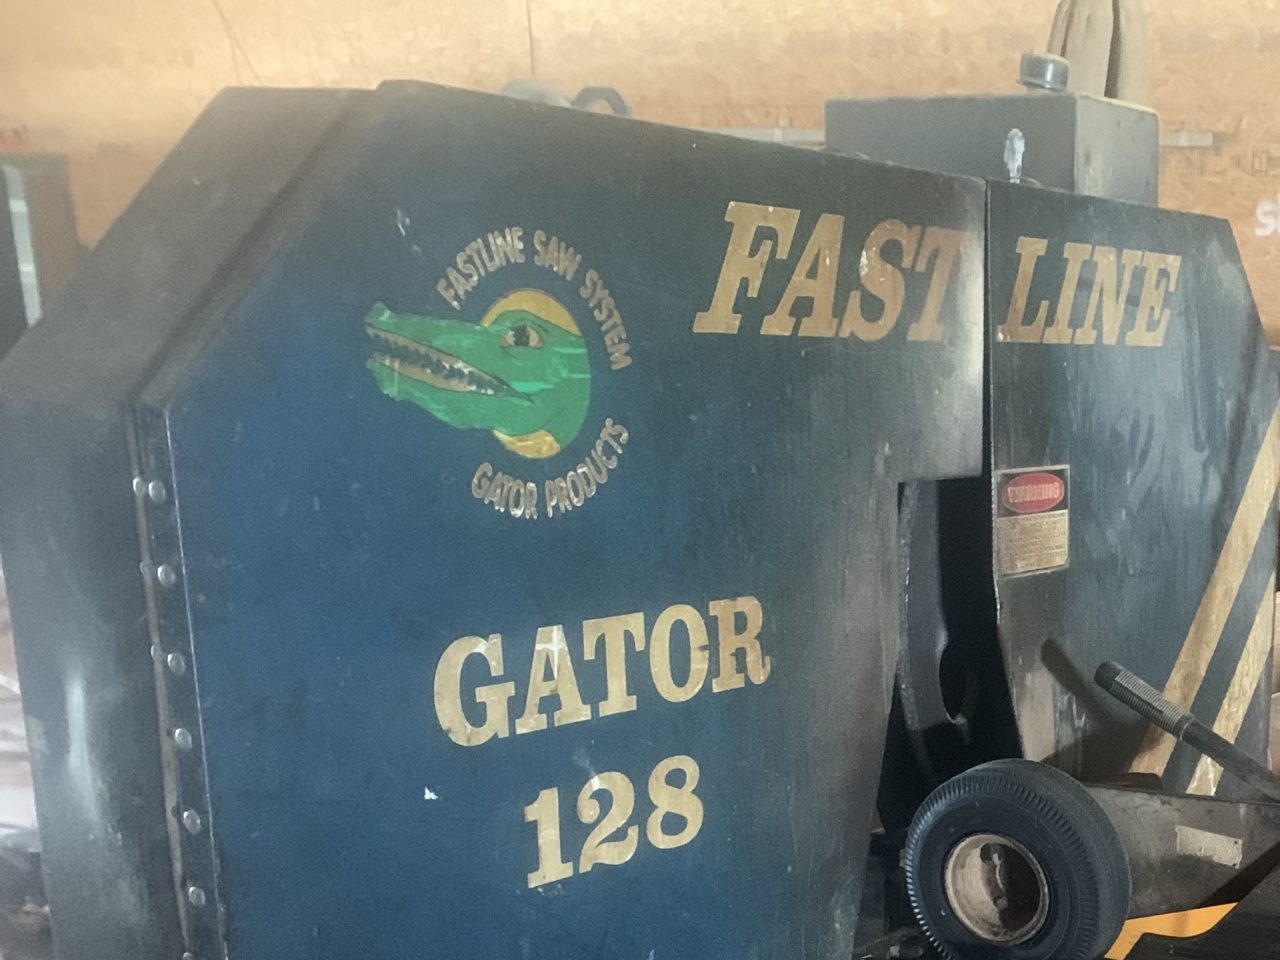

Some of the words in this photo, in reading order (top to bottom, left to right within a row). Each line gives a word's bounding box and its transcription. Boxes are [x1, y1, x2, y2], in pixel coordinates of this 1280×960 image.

[436, 226, 526, 310] FASTLINE
[533, 229, 583, 281] SAW
[579, 269, 633, 370] SYSTEM
[693, 200, 976, 342] FAST
[997, 236, 1182, 348] LINE
[471, 461, 538, 519] GATOR
[544, 417, 629, 518] PRODUCTS
[433, 595, 771, 747] GATOR
[523, 754, 704, 888] 128
